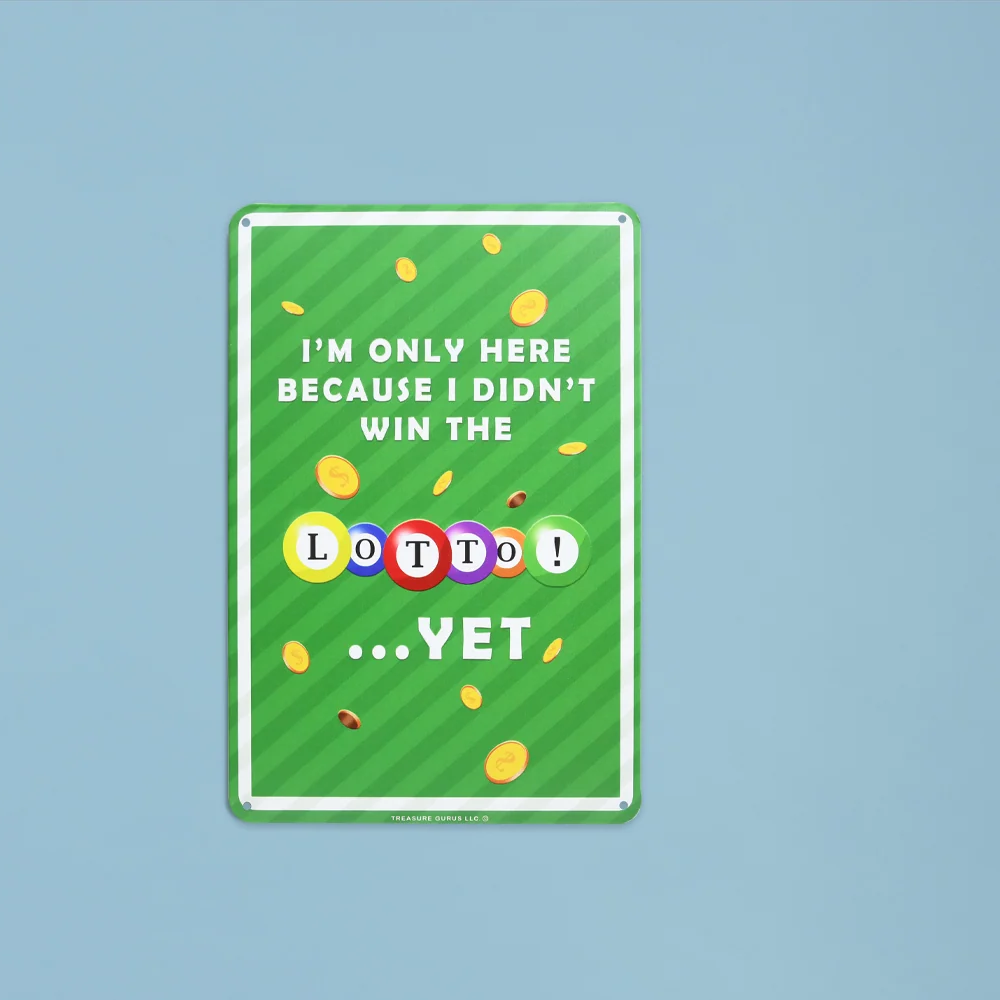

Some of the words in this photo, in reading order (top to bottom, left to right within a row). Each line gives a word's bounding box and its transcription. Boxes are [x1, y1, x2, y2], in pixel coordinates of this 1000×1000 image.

[302, 337, 353, 363] I'M
[368, 337, 465, 363] ONLY
[480, 338, 571, 363] HERE
[277, 376, 432, 403] BECAUSE
[448, 377, 456, 402] I
[473, 376, 596, 402] DIDN'T
[360, 416, 430, 441] WIN
[445, 416, 512, 441] THE
